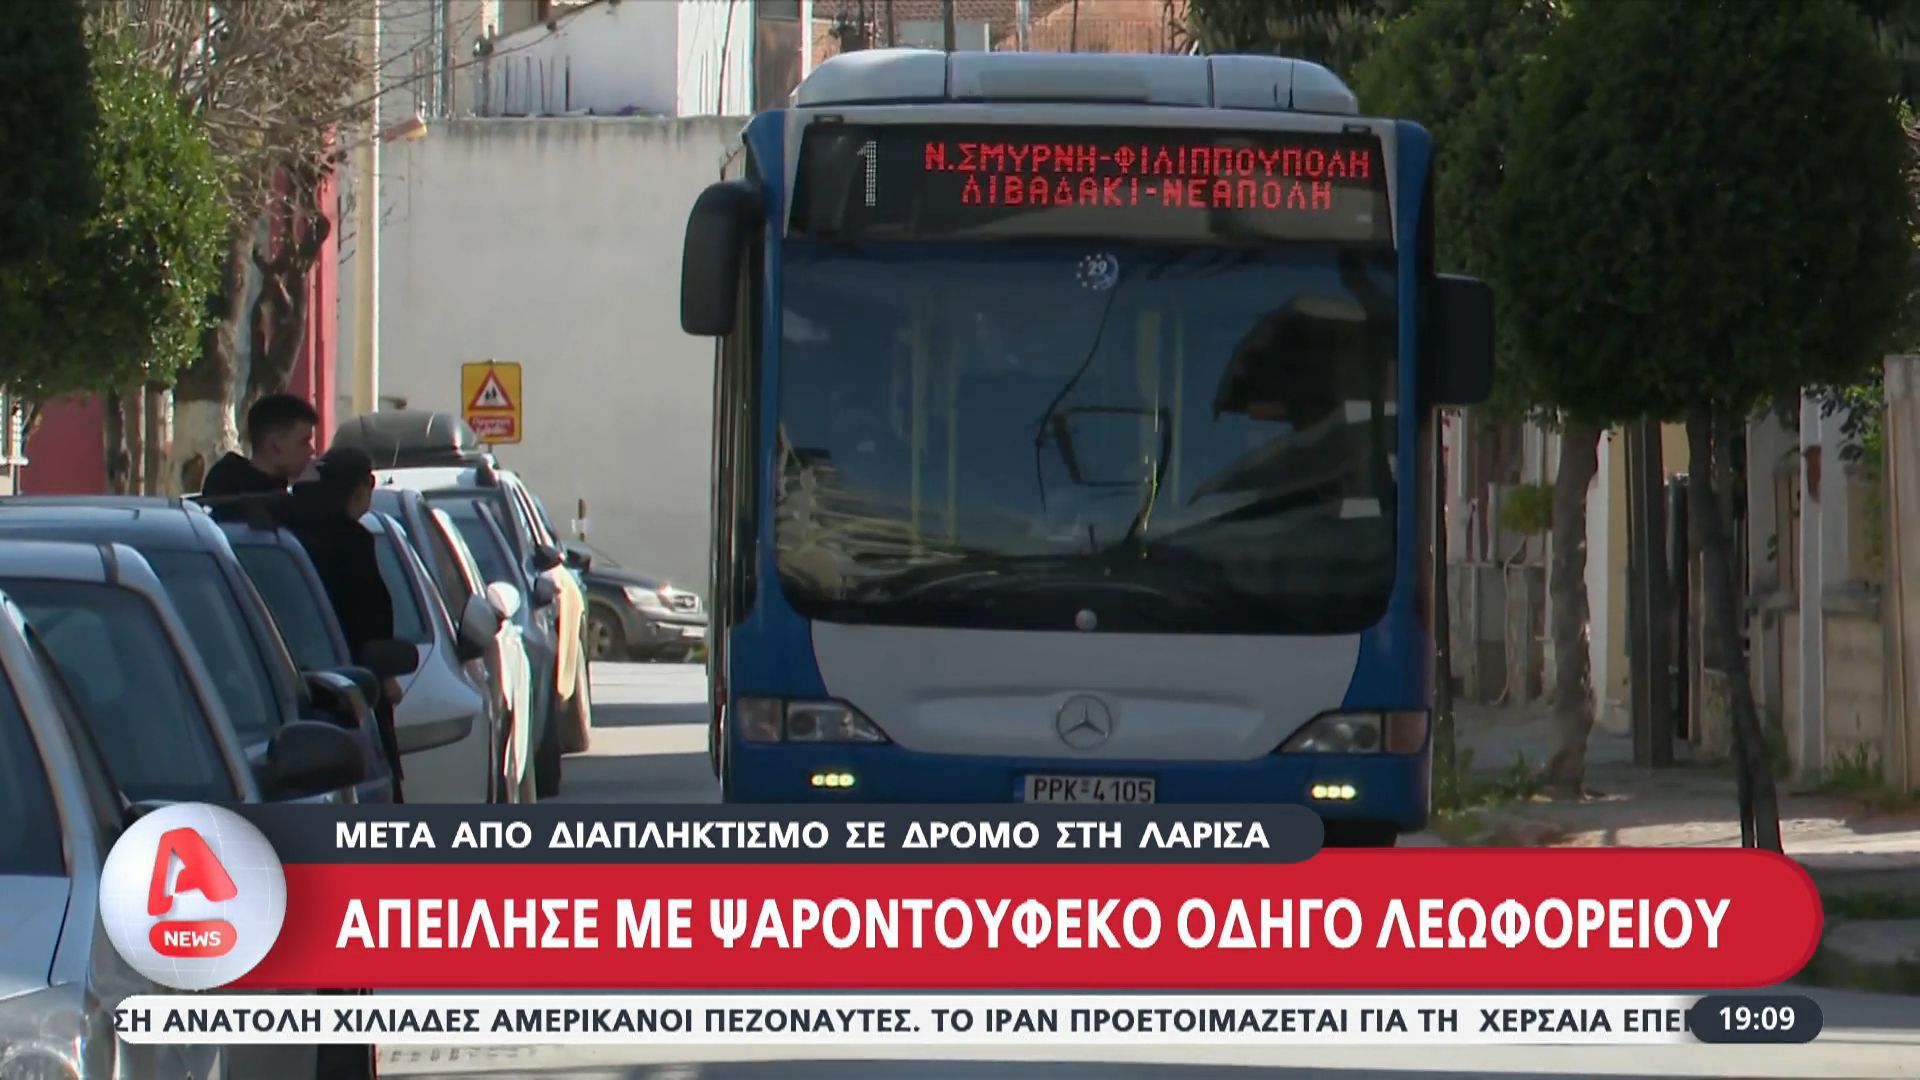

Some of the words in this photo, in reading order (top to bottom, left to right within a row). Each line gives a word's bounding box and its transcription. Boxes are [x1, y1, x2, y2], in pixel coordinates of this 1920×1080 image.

[857, 141, 877, 206] 1
[924, 142, 1370, 178] Ν.ΣΜΥΡΝΗ-ΦΙΛΙΠΠΟΥΠΟΛΗ
[961, 177, 1334, 210] ΛΙΒΑΔΑΚΙ-ΝΕΑΠΟΛΗ
